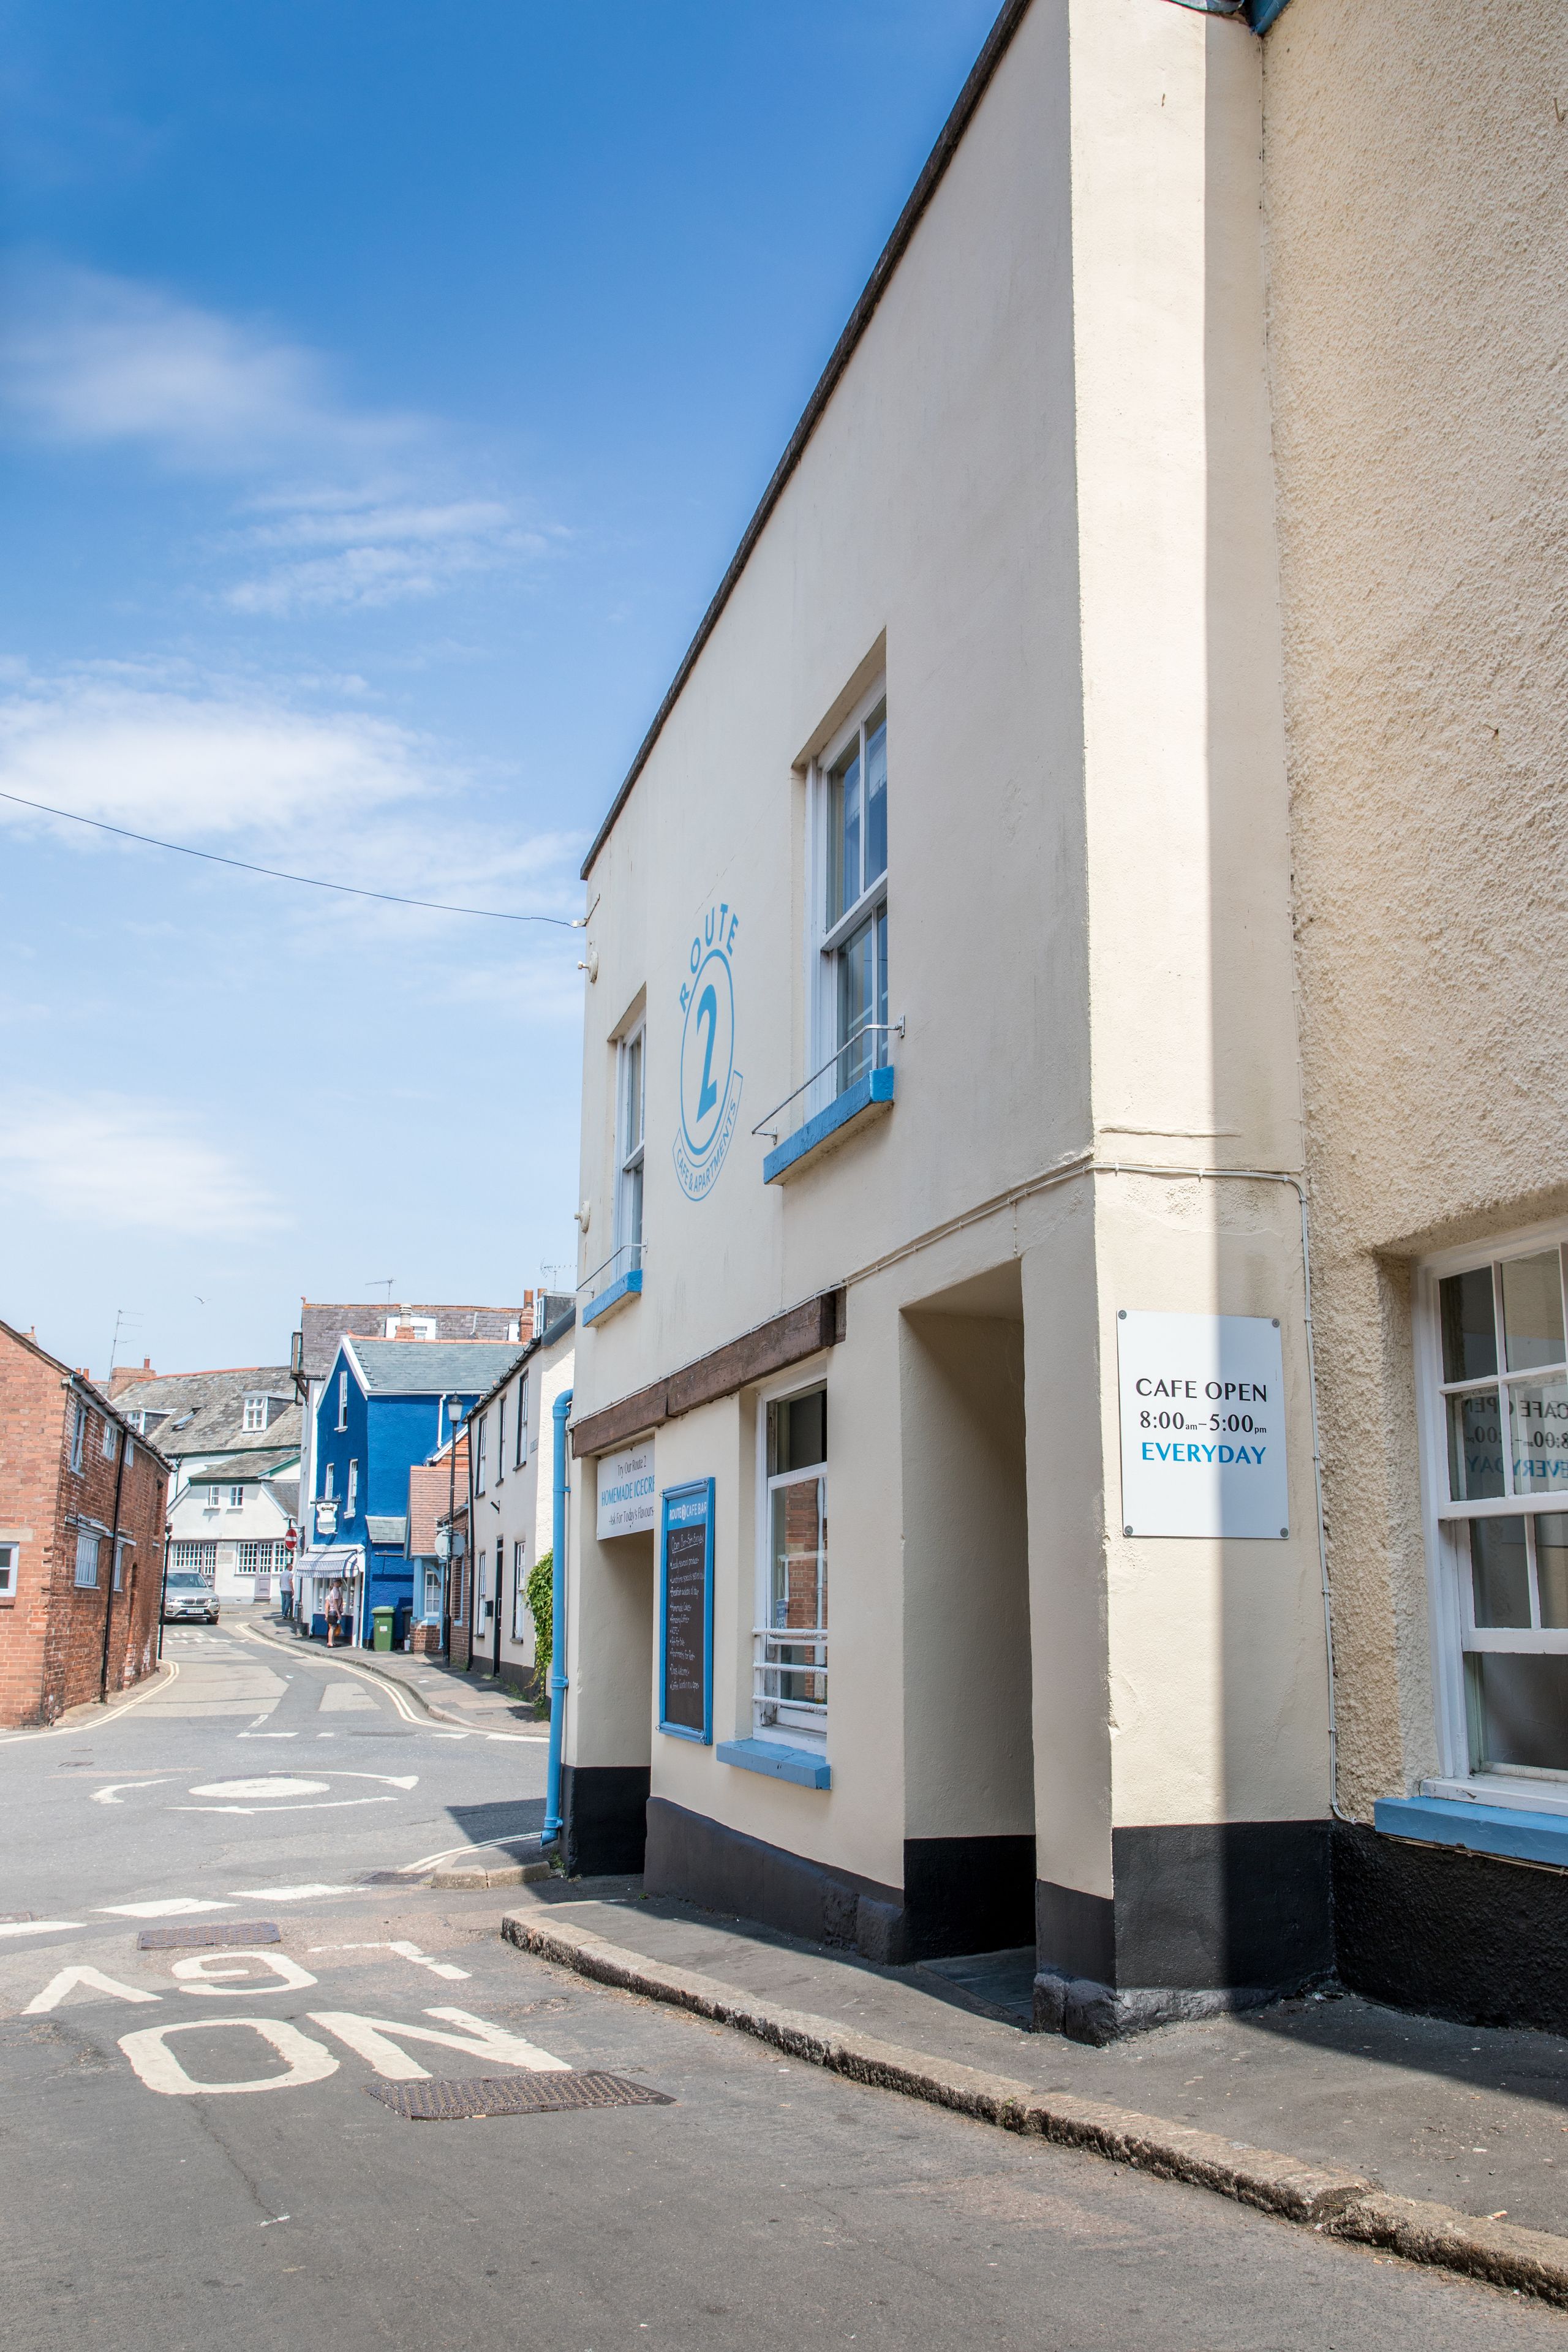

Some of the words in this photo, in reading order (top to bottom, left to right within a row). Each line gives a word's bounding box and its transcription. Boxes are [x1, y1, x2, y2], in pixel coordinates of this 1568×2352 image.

[680, 903, 739, 1014] ROUTE
[696, 984, 717, 1123] 2
[677, 1148, 689, 1186] CAFE
[689, 1173, 693, 1191] &
[694, 1098, 735, 1193] APARTMENTS
[1136, 1378, 1197, 1398] CAFE
[1205, 1382, 1267, 1402] OPEN
[633, 1459, 643, 1471] Route
[644, 1455, 646, 1467] 2
[1142, 1442, 1266, 1464] EVERYDAY
[601, 1483, 633, 1507] HOMEMADE
[624, 1507, 638, 1525] Today's
[669, 1507, 682, 1520] ROUTE
[686, 1504, 697, 1517] CAFE
[698, 1502, 707, 1514] BAR
[671, 1536, 680, 1551] Open
[777, 1617, 786, 1628] OPEN
[116, 2007, 573, 2095] NO
